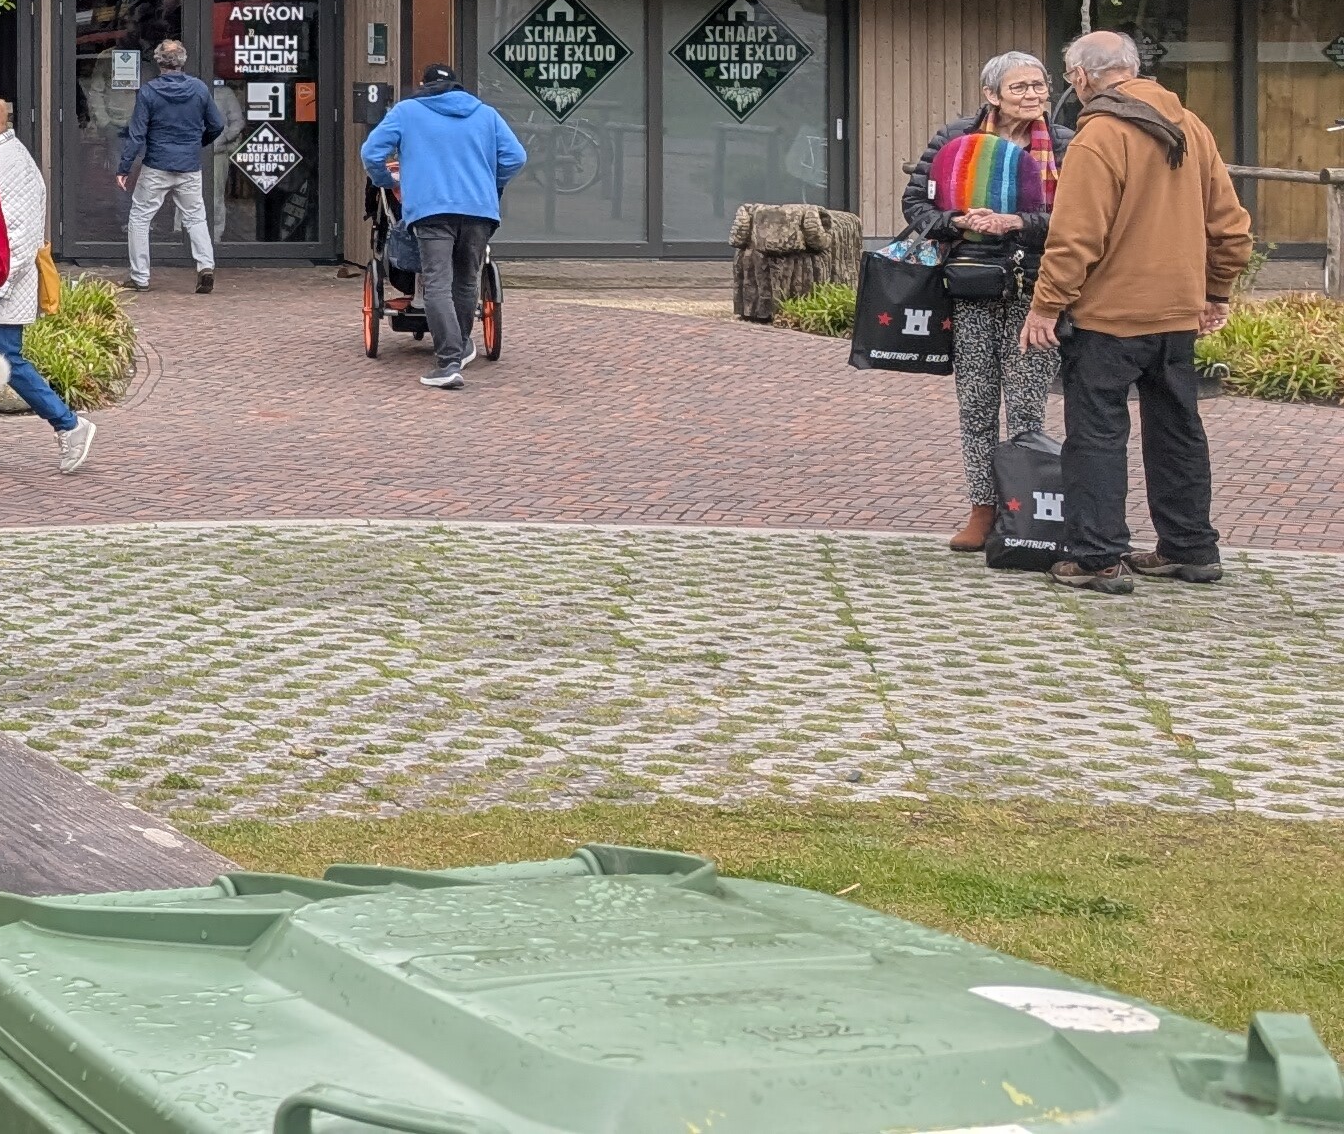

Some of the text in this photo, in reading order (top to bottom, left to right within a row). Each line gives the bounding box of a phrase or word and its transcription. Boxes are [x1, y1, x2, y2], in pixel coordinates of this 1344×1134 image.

[524, 26, 597, 43] SCHAAPS
[705, 26, 778, 43] SCHAAPS
[235, 35, 298, 50] LUNCH
[235, 50, 298, 64] ROOM
[504, 45, 616, 62] KUDDE EXLOO
[685, 44, 797, 62] KUDDE EXLOO
[235, 65, 298, 73] HALLENHOES
[538, 63, 583, 80] SHOP
[719, 62, 764, 80] SHOP
[367, 84, 379, 103] 8
[246, 143, 286, 153] SCHAAPS
[236, 153, 296, 163] KUDDE EXLOO
[254, 163, 279, 173] SHOP
[870, 349, 920, 361] SCHUTRUPS
[1004, 537, 1057, 551] SCHUTRUPS
